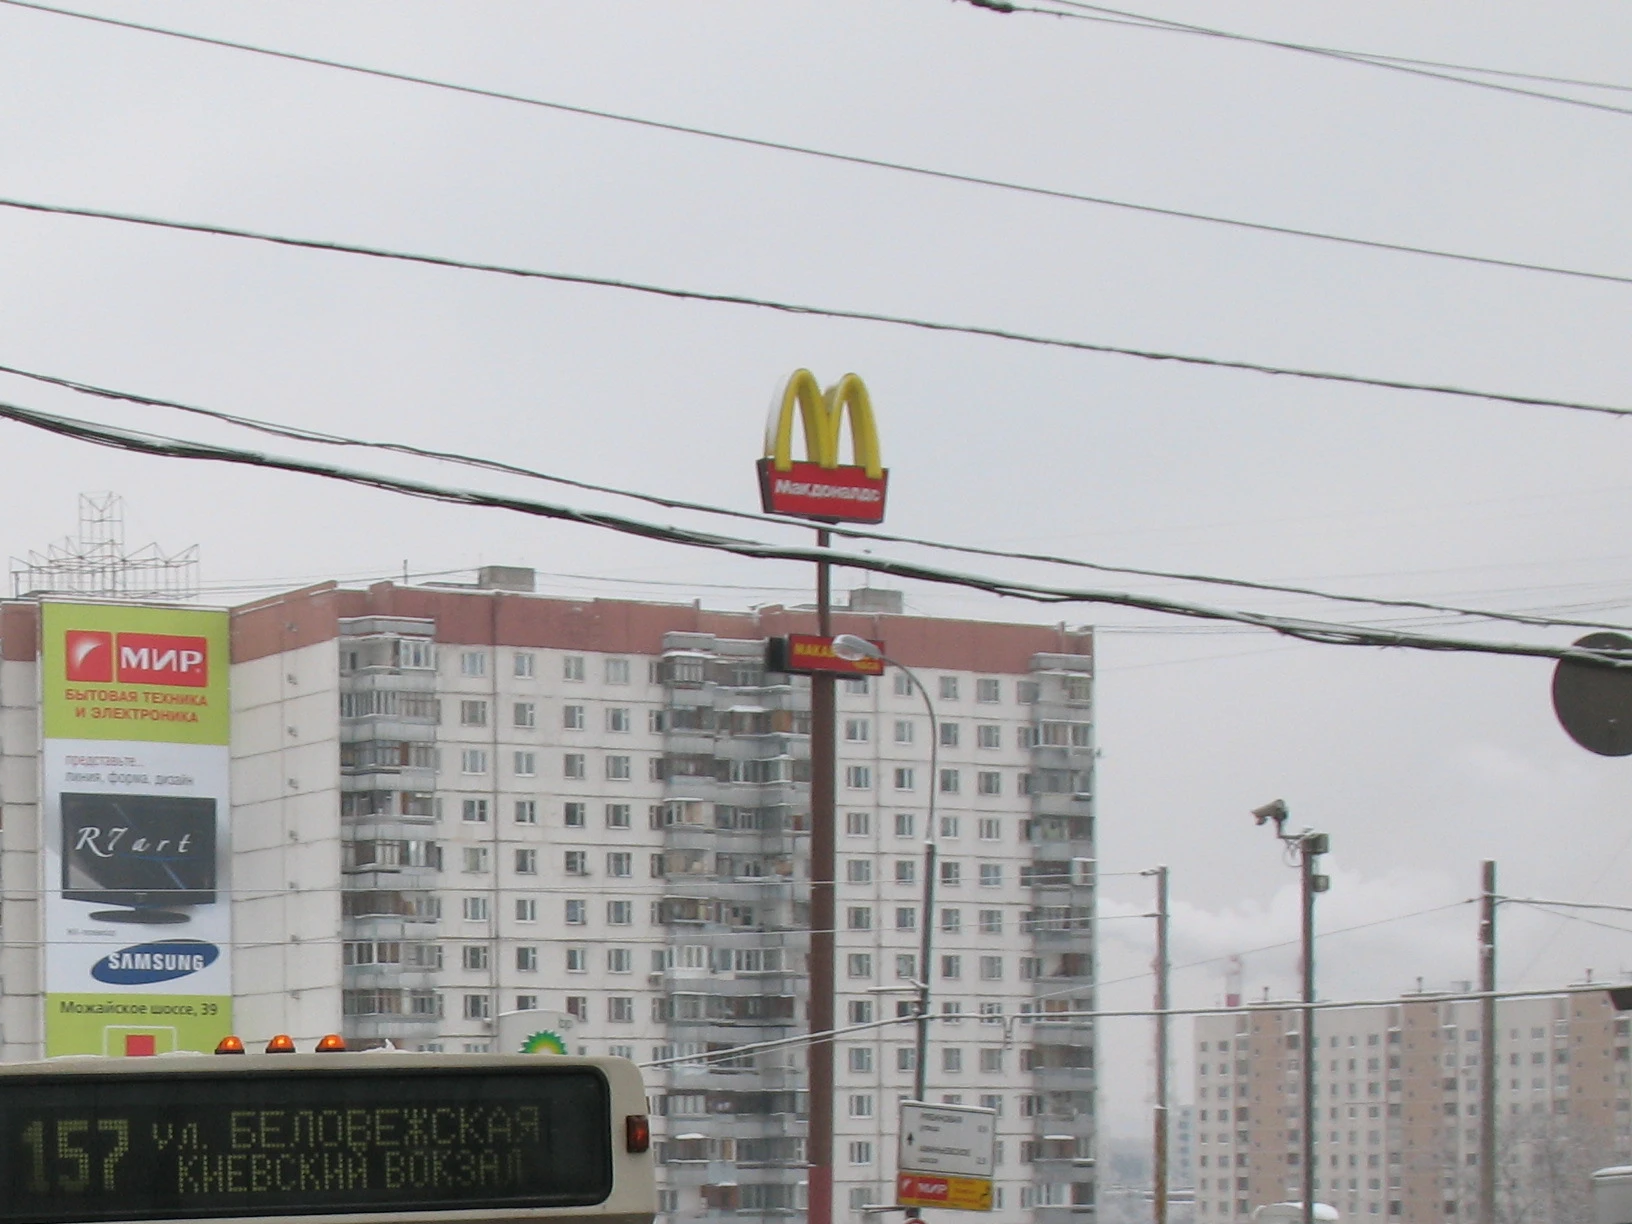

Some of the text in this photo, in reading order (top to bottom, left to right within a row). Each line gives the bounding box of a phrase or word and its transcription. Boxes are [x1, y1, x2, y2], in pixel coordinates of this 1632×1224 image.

[120, 646, 204, 673] МИР
[64, 688, 208, 706] БЫТОВАЯ ТЕХНИКА
[75, 706, 199, 722] И ЭЛЕКТРОНИКА
[108, 952, 205, 971] SAMSUNG
[60, 1000, 217, 1017] Можайское шоссе, 39
[230, 1105, 540, 1149] БЕЛОВЕЖСКАЯ
[23, 1119, 129, 1192] 157
[177, 1147, 368, 1193] КИЕВСКИЙ
